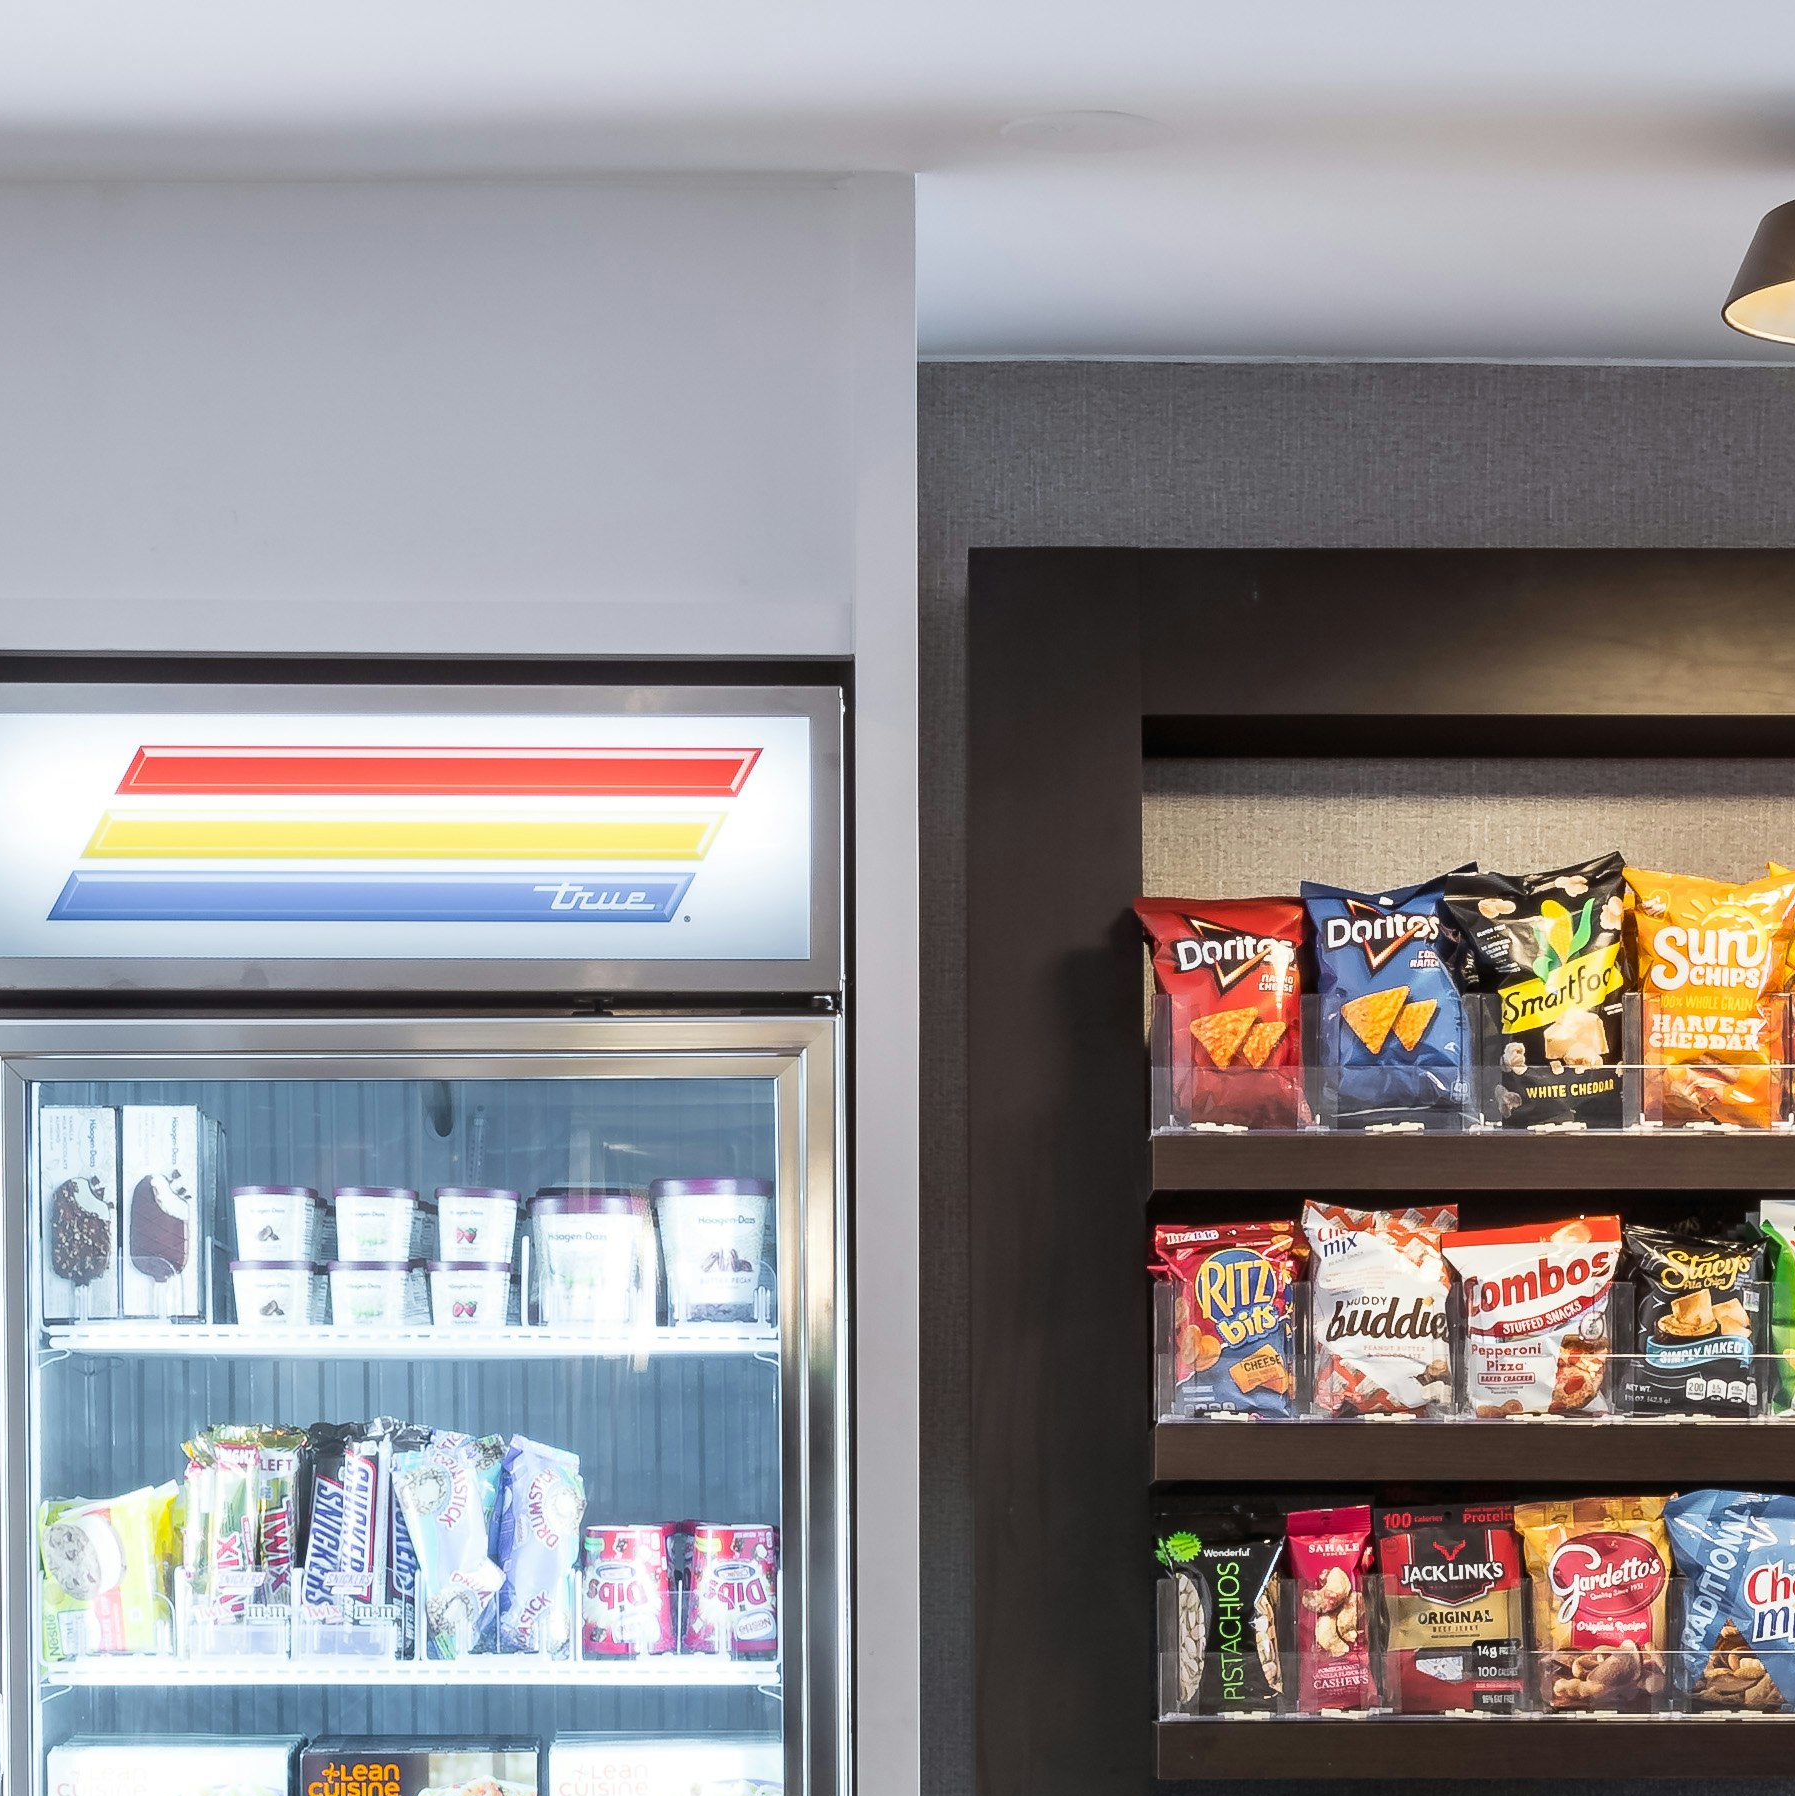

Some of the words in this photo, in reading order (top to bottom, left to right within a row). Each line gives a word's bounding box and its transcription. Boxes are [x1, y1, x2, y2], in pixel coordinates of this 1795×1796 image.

[1327, 914, 1440, 948] Doritos
[1650, 924, 1767, 991] Sun
[1689, 966, 1761, 989] CHIPS
[1685, 996, 1719, 1010] WHOLE
[1720, 997, 1755, 1011] GRAIN
[1651, 1014, 1766, 1034] HARVEST
[1648, 1032, 1761, 1052] CHEDDAR
[1526, 1084, 1567, 1099] WHITE
[1570, 1079, 1614, 1096] CHEDDAR
[1323, 1232, 1358, 1257] mix
[1661, 1251, 1752, 1290] Stacy's
[1201, 1260, 1271, 1319] RITZ
[1464, 1252, 1610, 1317] Combos
[1346, 1296, 1387, 1308] MUDDY
[1219, 1306, 1276, 1344] bits
[1503, 1317, 1544, 1335] STUFFED
[1546, 1300, 1583, 1325] SNACKS
[1472, 1343, 1542, 1358] Pepperoni
[1704, 1342, 1742, 1355] NAKED
[1244, 1355, 1282, 1372] CHEESE
[1486, 1360, 1524, 1371] Pizza
[260, 1458, 293, 1472] LEFT
[1382, 1513, 1411, 1529] 100
[1462, 1511, 1513, 1524] Protein
[263, 1496, 291, 1594] TWIX
[306, 1484, 344, 1607] SNICKERS
[1204, 1547, 1250, 1558] Wonderful
[1308, 1543, 1360, 1553] SAHALE
[1401, 1565, 1446, 1585] JACK
[1447, 1562, 1504, 1580] LINK'S
[1549, 1544, 1661, 1624] Gardetto's
[1417, 1609, 1493, 1625] ORIGINAL
[1217, 1562, 1246, 1700] PISTACHIOS
[1477, 1666, 1496, 1677] 100
[1313, 1674, 1369, 1690] CASHEWS
